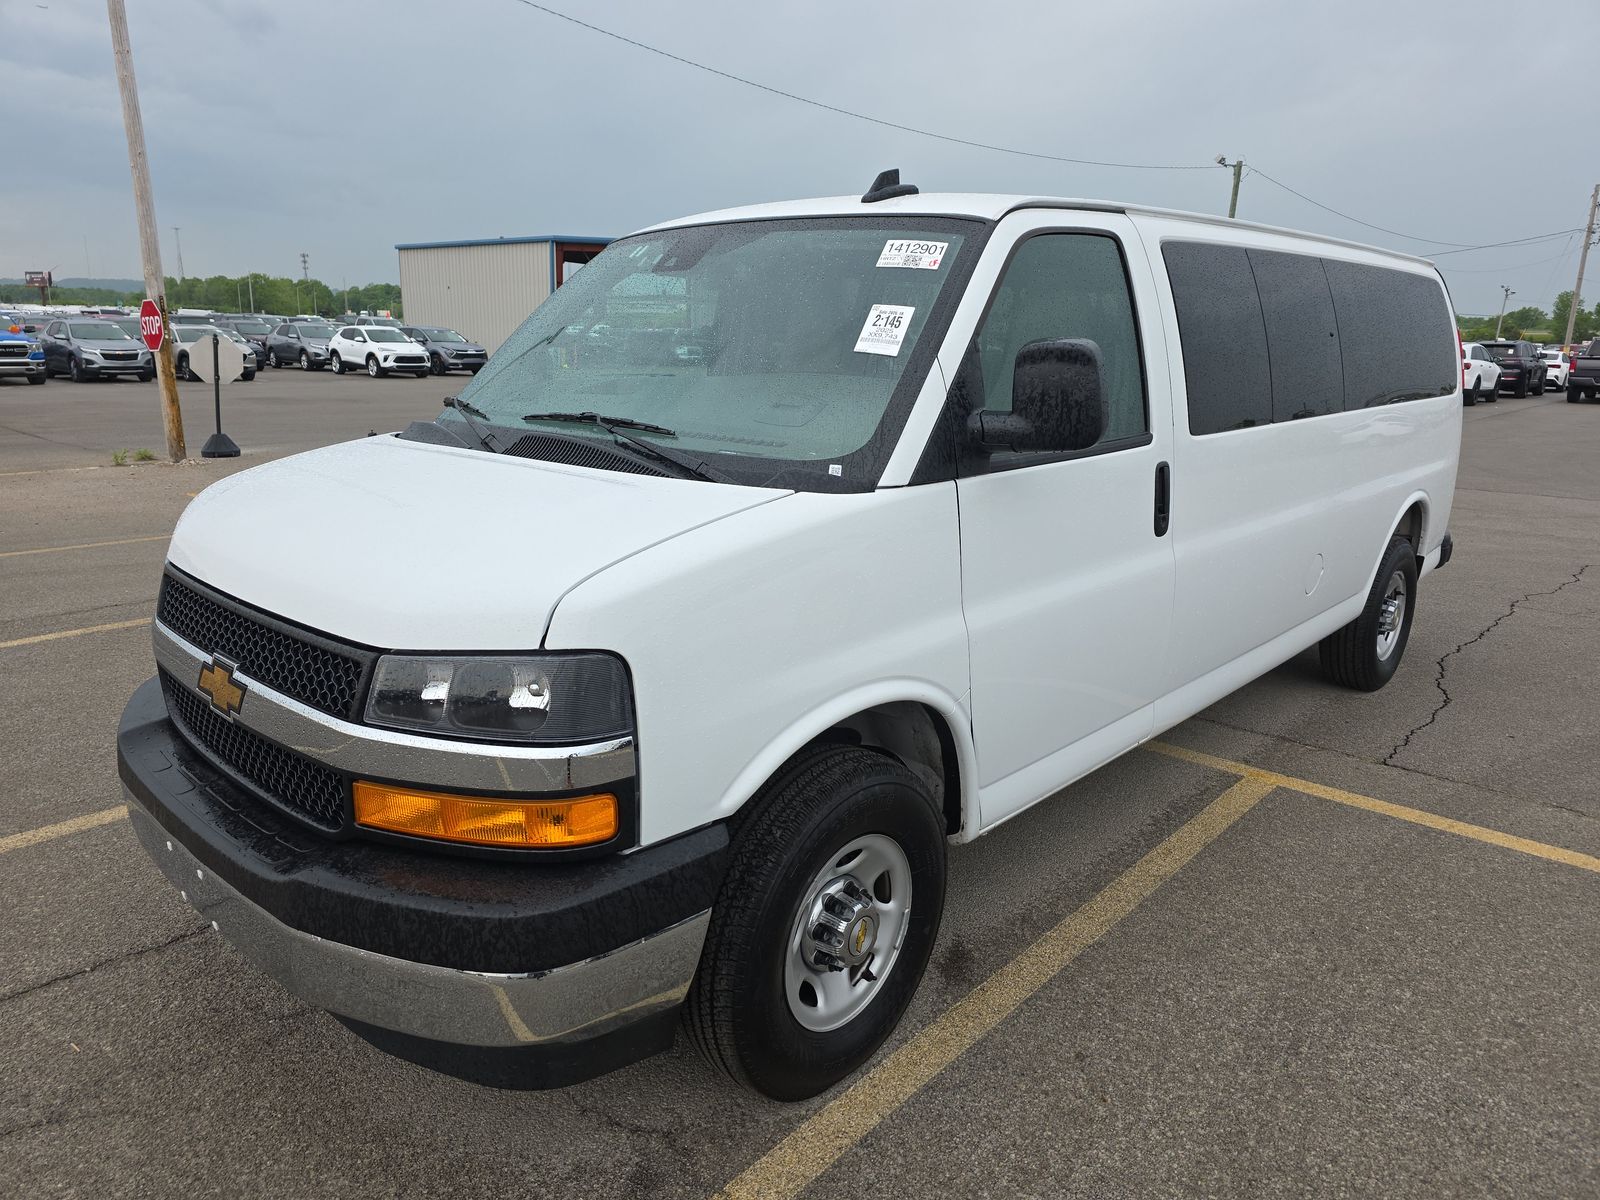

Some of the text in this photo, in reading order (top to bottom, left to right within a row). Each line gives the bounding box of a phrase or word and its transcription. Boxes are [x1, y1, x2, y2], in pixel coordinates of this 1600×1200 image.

[888, 242, 944, 255] 1412901
[142, 316, 161, 335] STOP
[872, 314, 903, 328] 2:145
